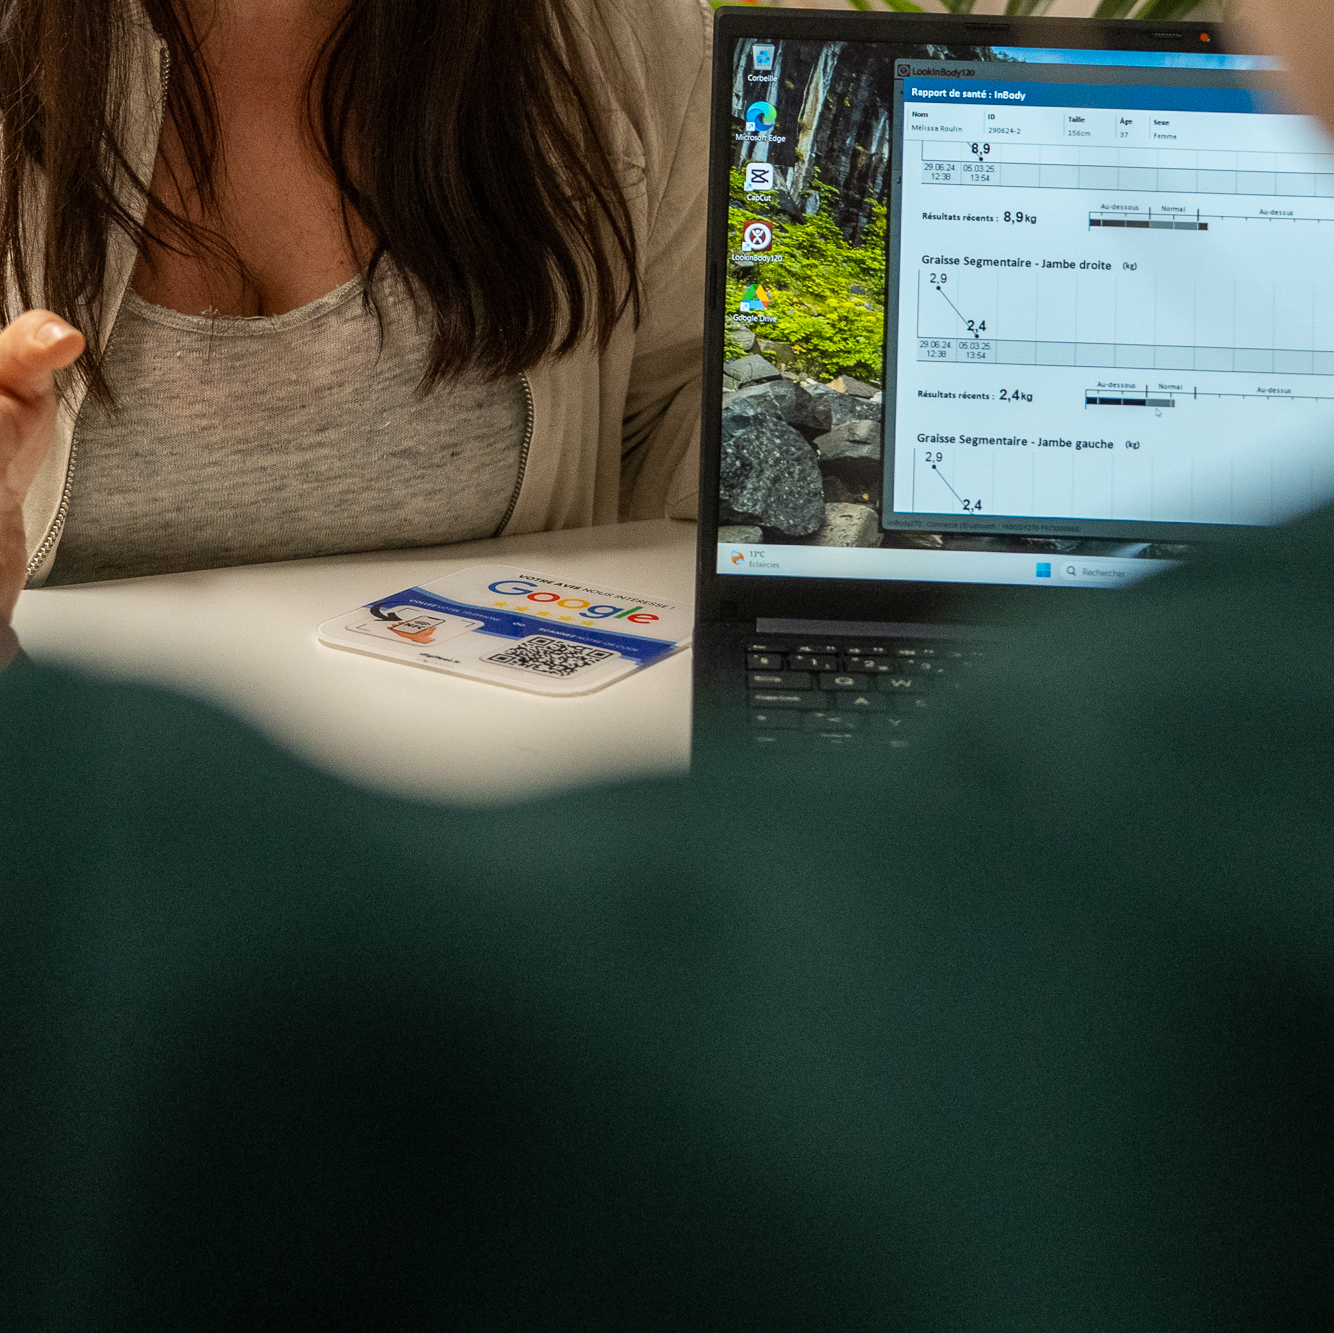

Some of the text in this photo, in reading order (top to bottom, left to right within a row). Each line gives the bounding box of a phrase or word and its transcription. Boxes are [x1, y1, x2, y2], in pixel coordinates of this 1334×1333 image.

[747, 74, 778, 82] Corbeille
[911, 87, 947, 99] Rapport
[949, 89, 960, 98] de
[962, 90, 987, 99] santé
[994, 91, 1026, 102] InBody
[911, 124, 938, 132] Mélissa
[1068, 129, 1091, 137] 156cm
[1153, 132, 1177, 140] Femme
[735, 133, 786, 144] Microsoft Edge
[971, 142, 990, 156] 8,9
[931, 172, 951, 181] 12:38
[970, 174, 990, 182] 13:54
[747, 194, 771, 202] CapCut
[1101, 203, 1139, 211] Au-dessous
[922, 212, 961, 221] Résultats
[963, 213, 994, 222] récents
[921, 254, 960, 266] Graisse
[963, 256, 1032, 269] Segmentaire
[1041, 259, 1076, 270] Jambe
[1079, 260, 1112, 270] droite
[1122, 261, 1137, 271] (kg)
[929, 272, 948, 285] 2,9
[733, 314, 777, 323] Google Drive
[967, 320, 986, 334] 2,4
[927, 350, 946, 358] 12:38
[966, 351, 986, 359] 13:54
[1097, 381, 1136, 389] Au-dessous
[1257, 386, 1292, 394] Au-dessus
[917, 390, 956, 399] Résultats
[958, 391, 990, 400] récents
[917, 433, 955, 444] Graisse
[959, 434, 1028, 447] Segmentaire
[1037, 437, 1072, 448] Jambe
[1075, 438, 1114, 450] gauche
[1125, 440, 1140, 450] (kg)
[925, 451, 943, 463] 2,9
[963, 499, 982, 512] 2,4
[1082, 568, 1126, 577] Rechercher
[519, 574, 553, 585] VOTRE
[554, 581, 582, 590] AVIS
[582, 588, 614, 597] NOUS
[488, 580, 659, 625] Google
